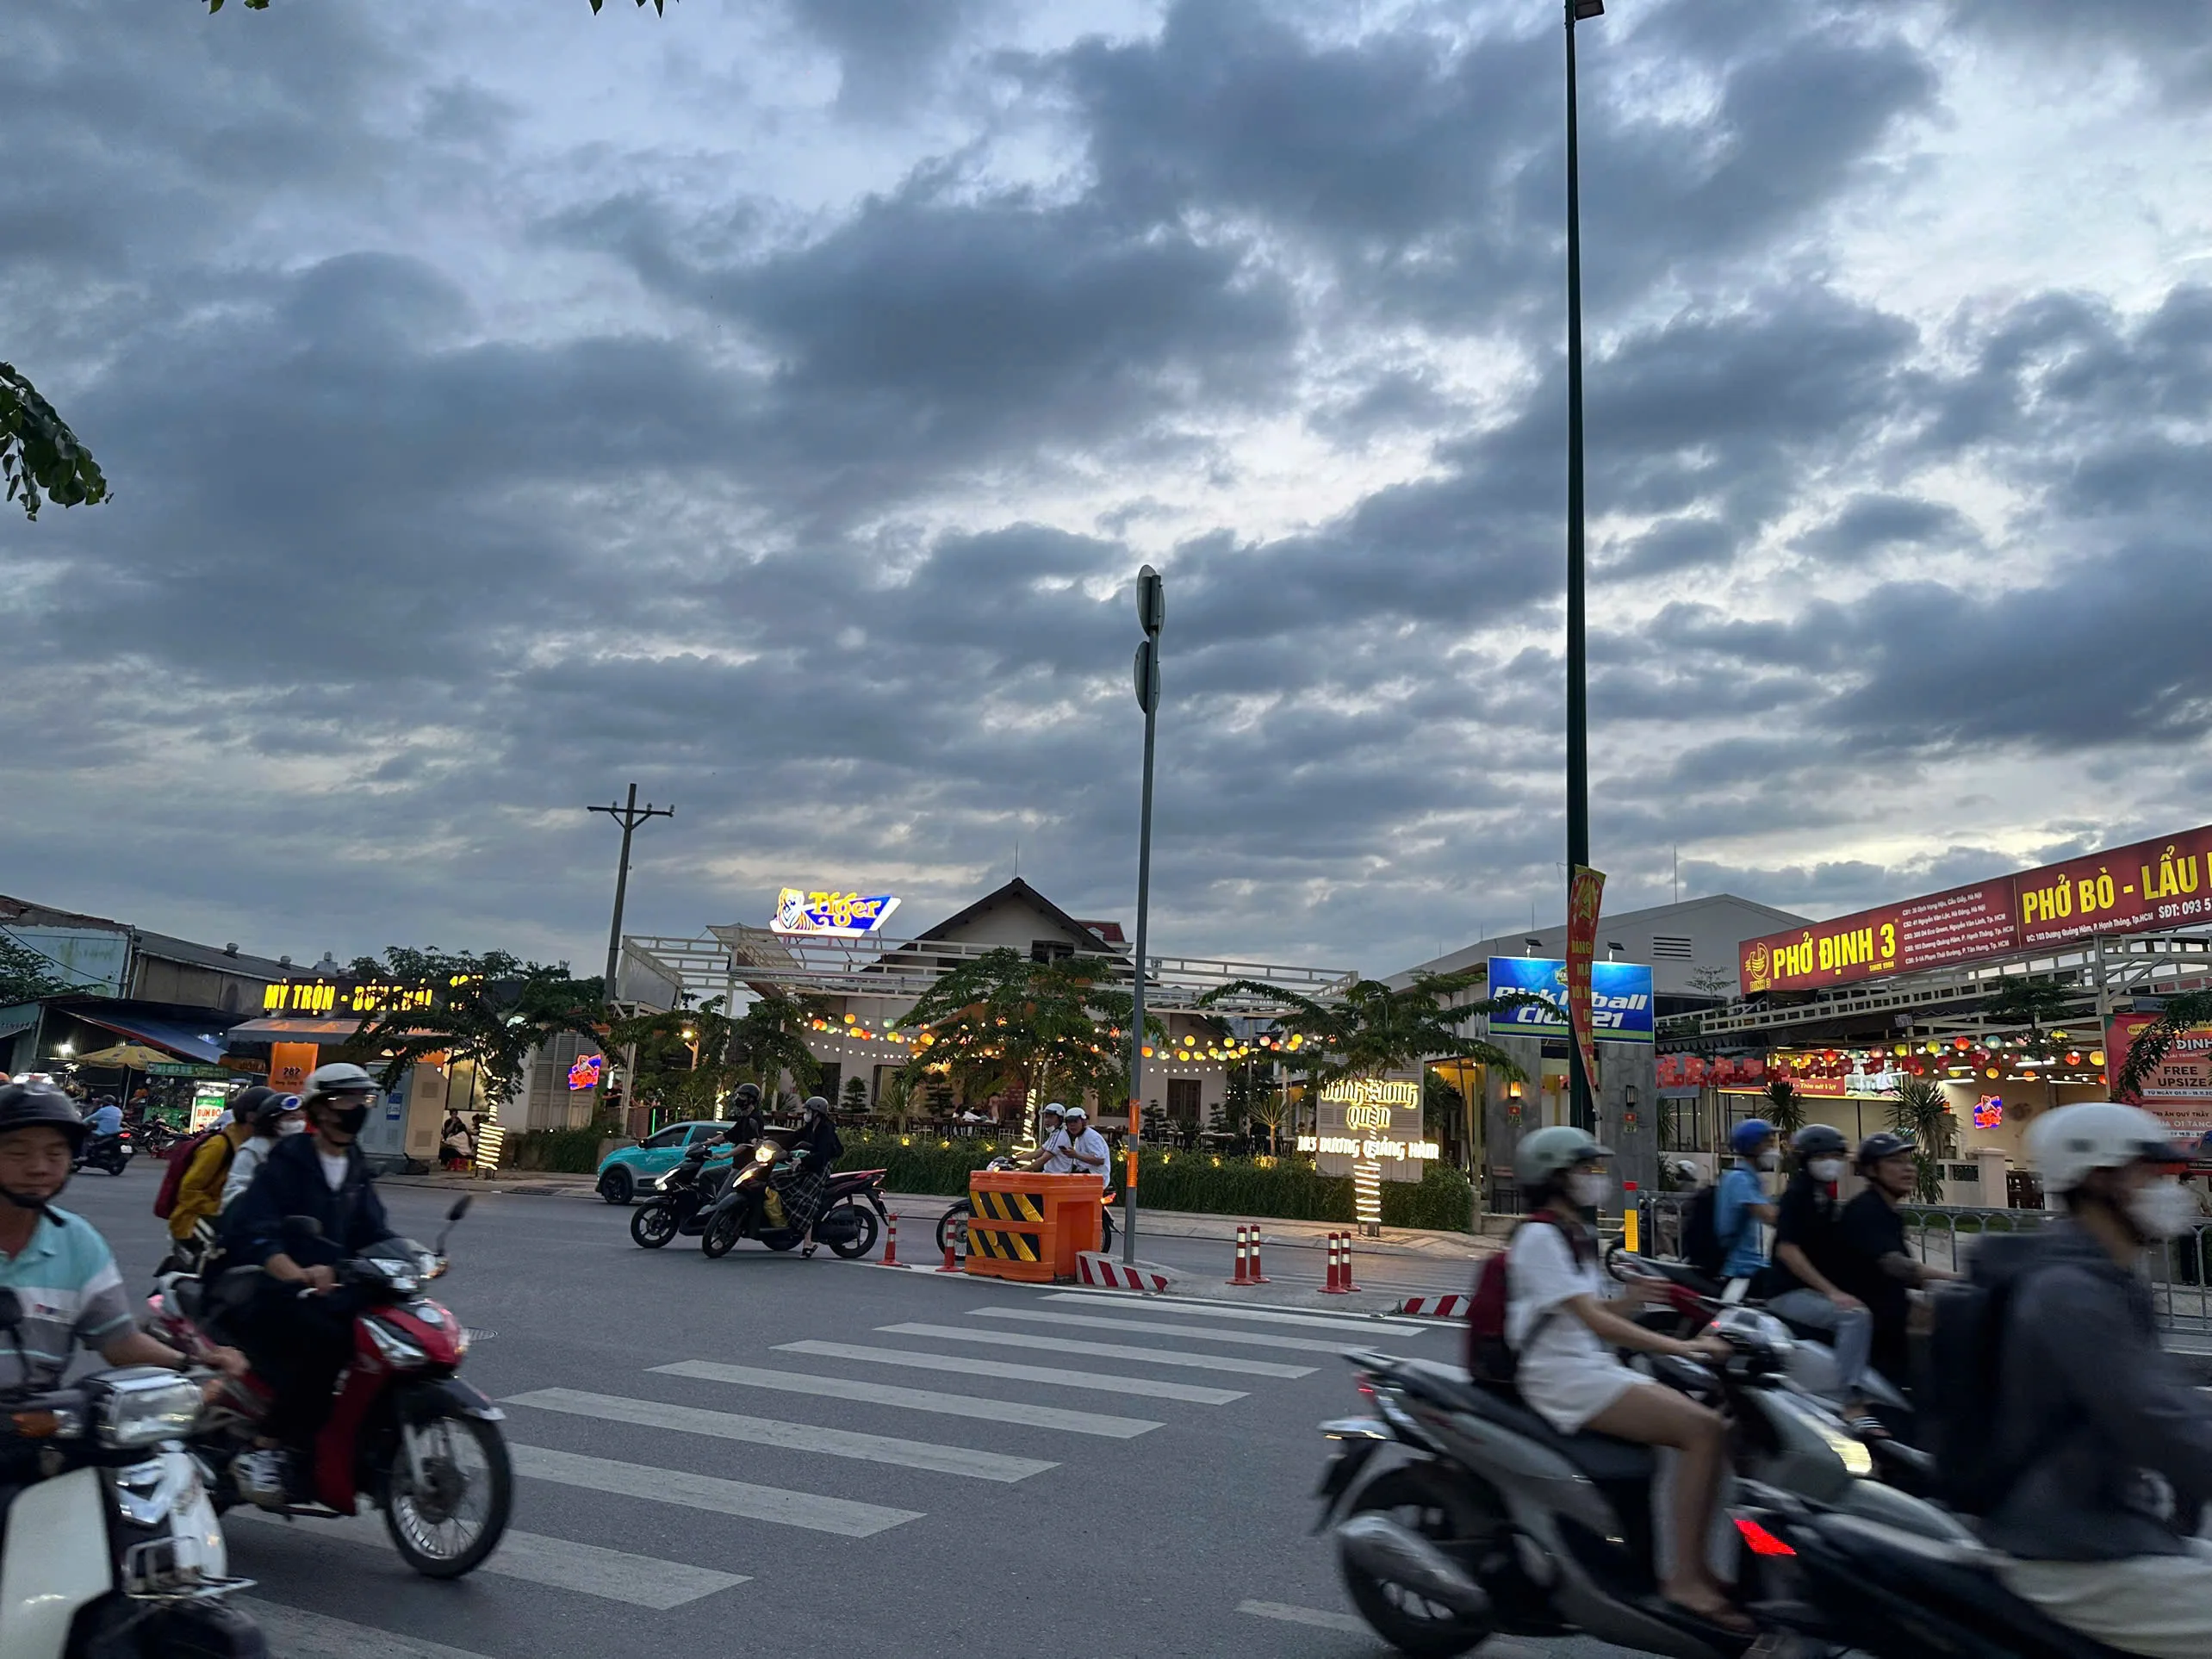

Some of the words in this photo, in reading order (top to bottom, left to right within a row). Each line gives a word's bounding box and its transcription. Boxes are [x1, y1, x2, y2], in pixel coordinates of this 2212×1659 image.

[2022, 873, 2072, 924] PHỞ
[2078, 867, 2115, 914] BÒ
[2141, 844, 2199, 901] LẨU
[808, 891, 881, 927] Tiger
[2158, 904, 2180, 919] SĐT:
[2182, 899, 2202, 916] 093
[1773, 931, 1814, 979] PHỞ
[1818, 927, 1873, 976] ĐỊNH
[1880, 923, 1896, 959] 3
[293, 978, 335, 1015] TRỘN
[2158, 1078, 2207, 1087] UPSIZE
[2164, 1066, 2198, 1075] FREE
[1296, 1135, 1318, 1152] 103
